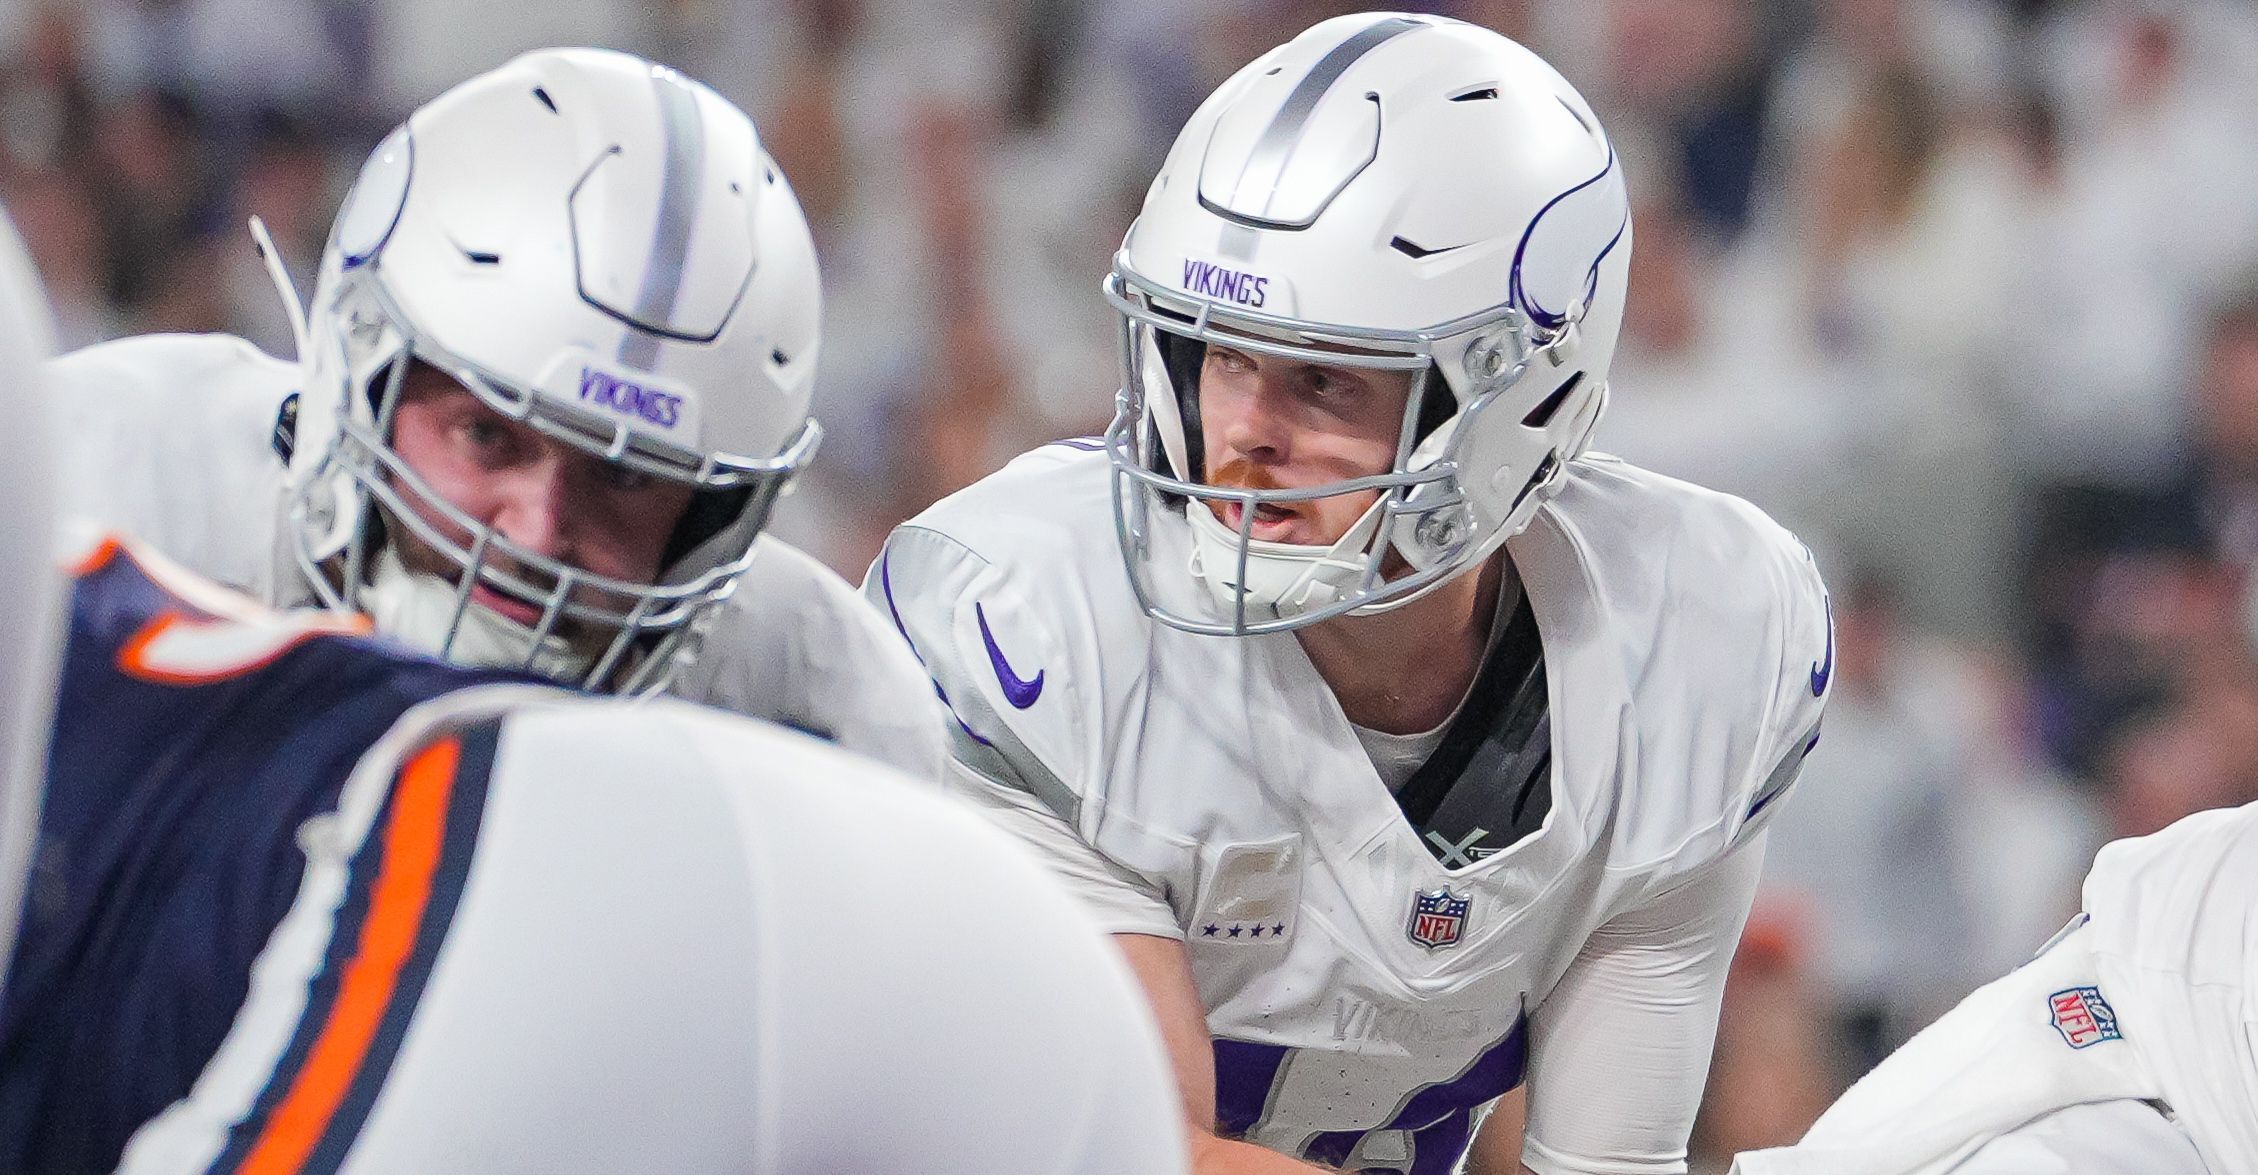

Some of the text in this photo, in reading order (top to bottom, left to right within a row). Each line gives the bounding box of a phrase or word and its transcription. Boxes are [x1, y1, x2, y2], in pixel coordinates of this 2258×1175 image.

[1183, 257, 1268, 308] VIKINGS
[581, 367, 681, 427] VIKINGS
[1415, 915, 1457, 942] NFL
[2053, 992, 2097, 1043] NFL
